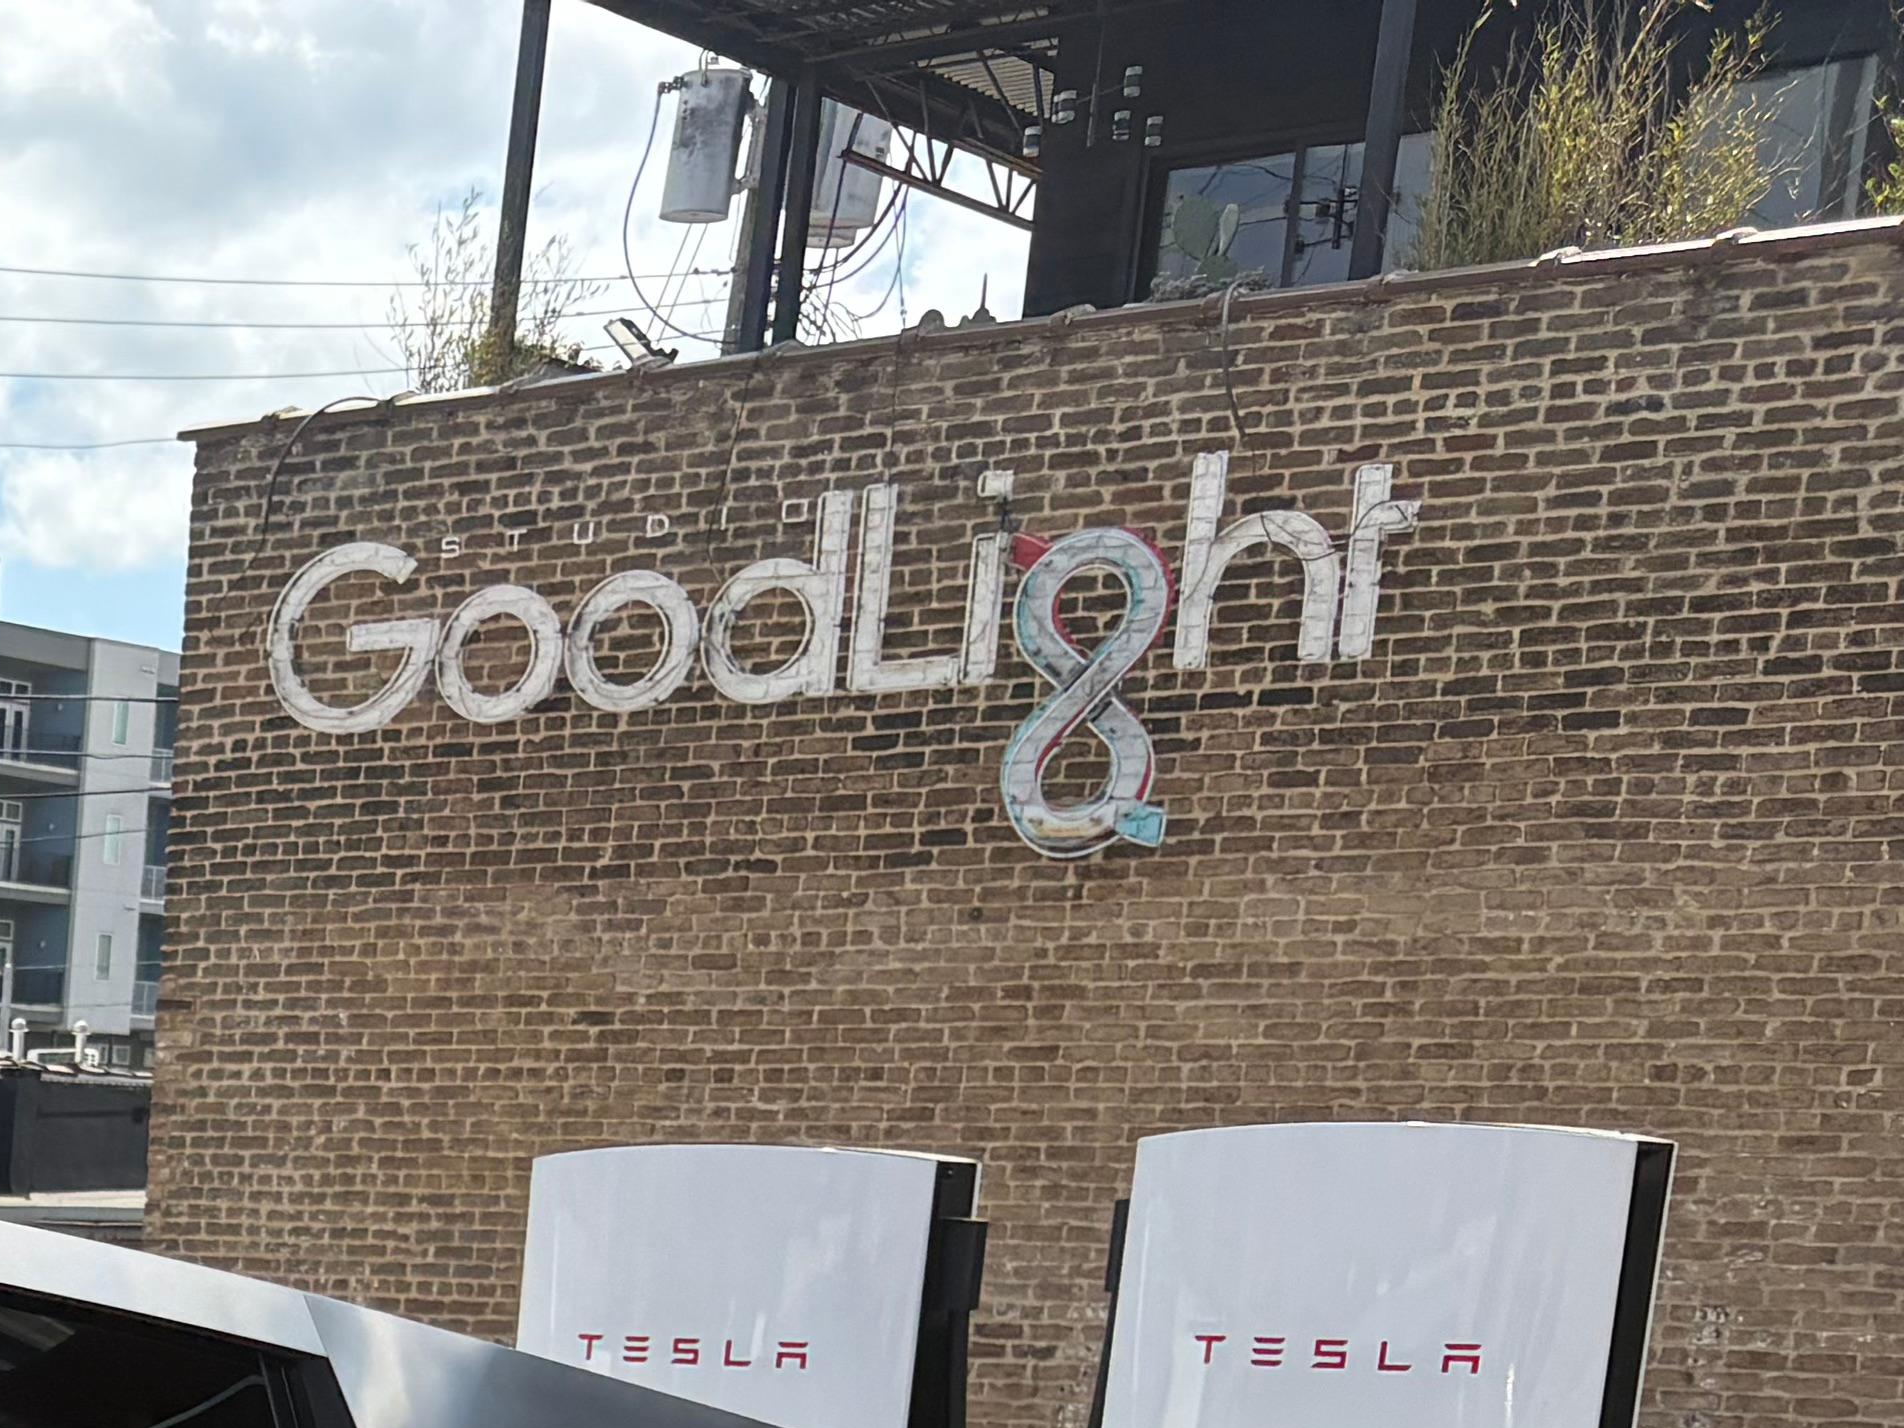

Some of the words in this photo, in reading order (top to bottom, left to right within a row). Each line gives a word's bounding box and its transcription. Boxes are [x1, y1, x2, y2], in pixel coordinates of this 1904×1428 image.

[442, 499, 808, 558] STUDIO
[578, 1333, 809, 1370] TESLA
[1194, 1335, 1482, 1375] TESLA
